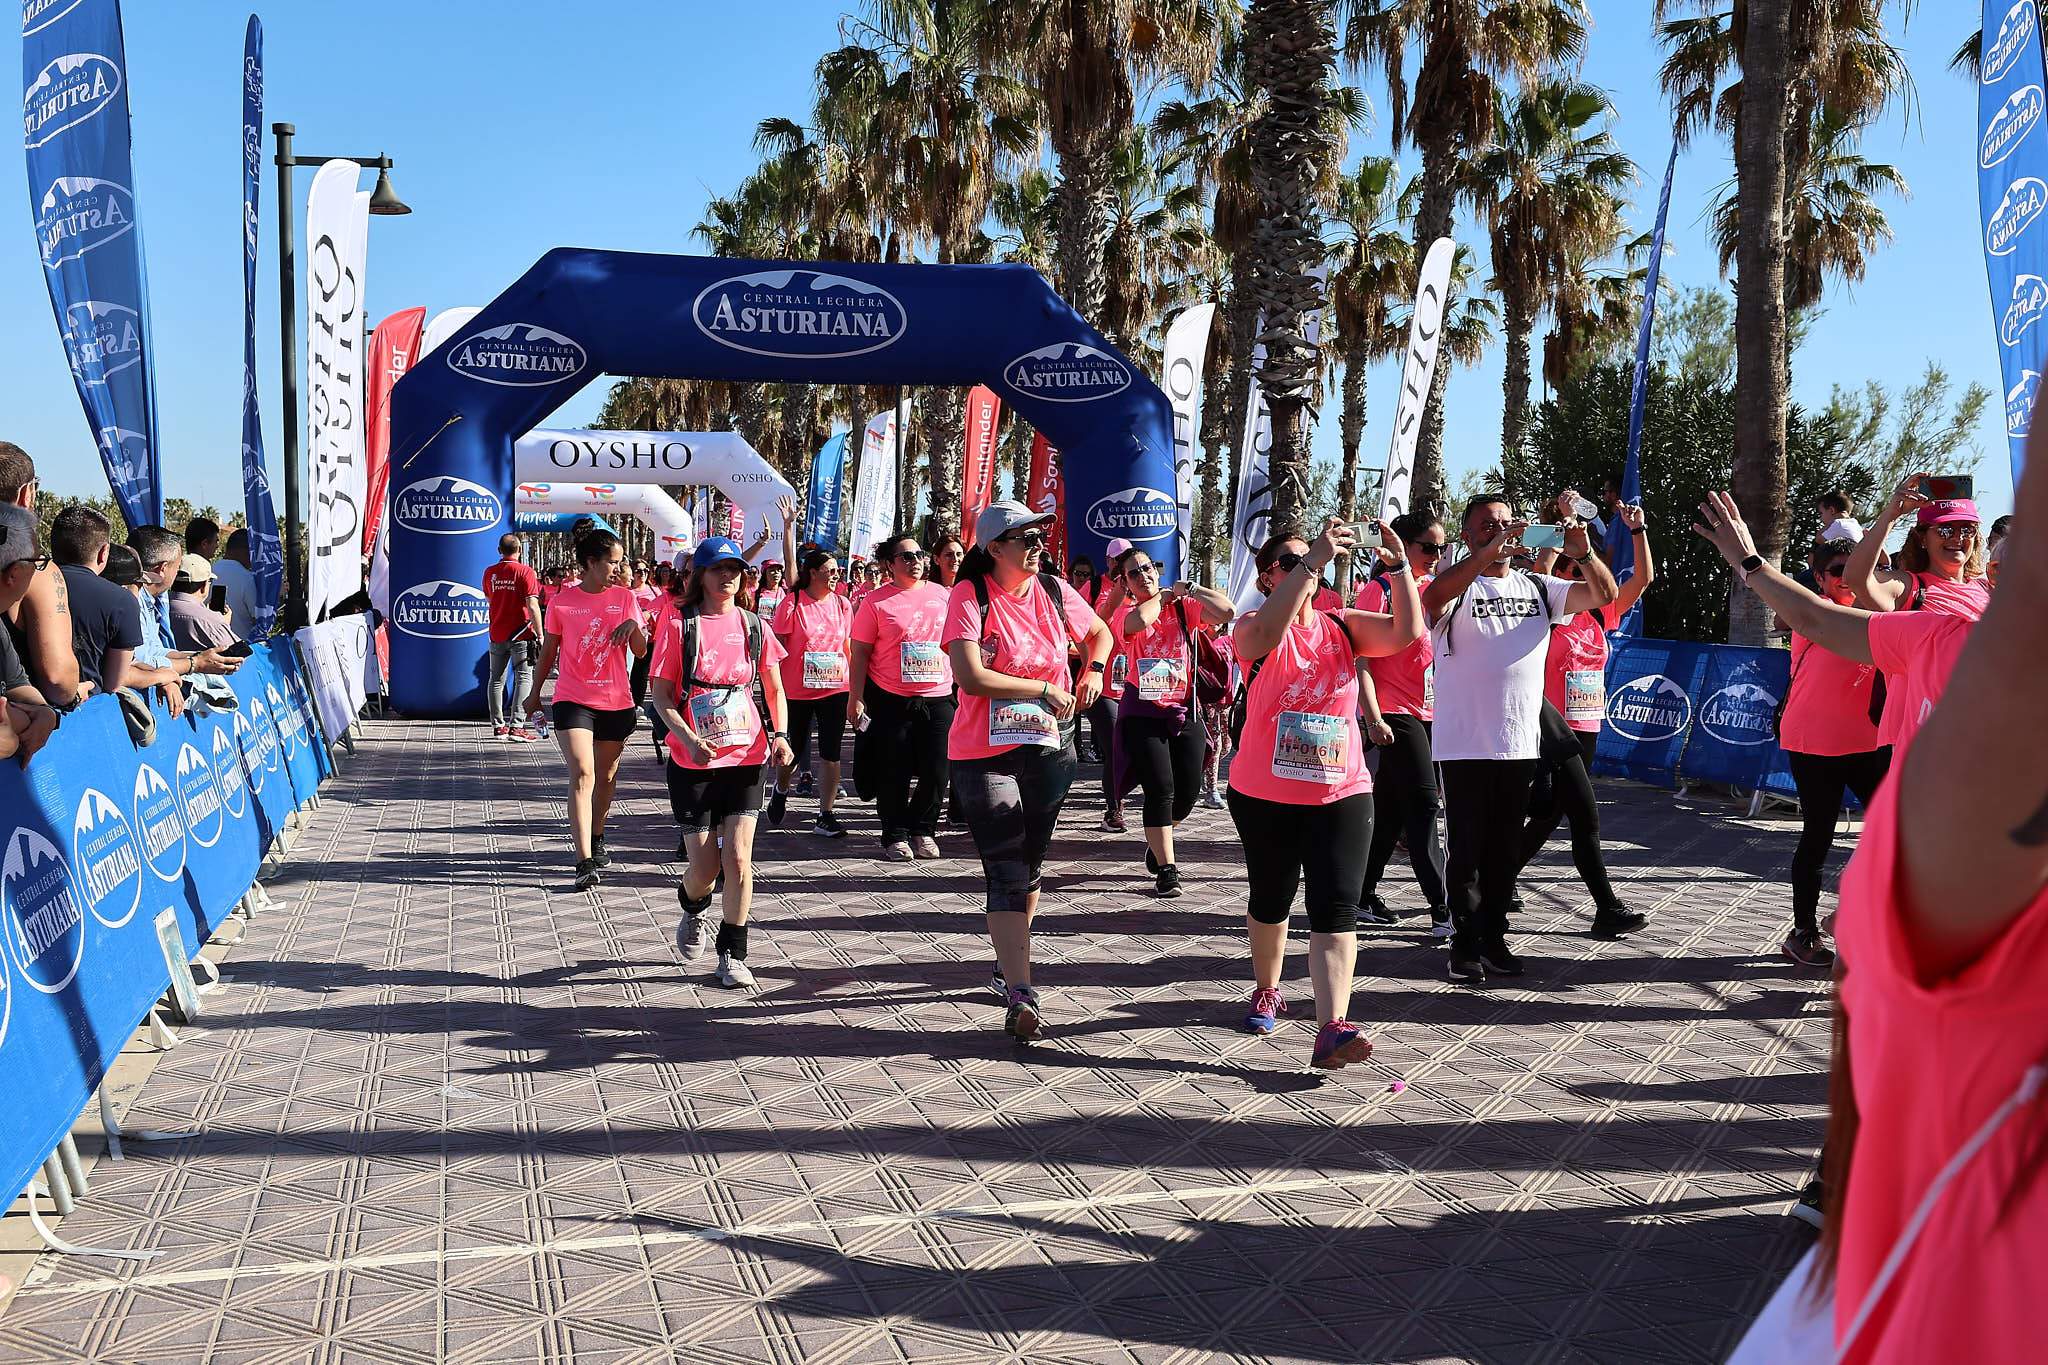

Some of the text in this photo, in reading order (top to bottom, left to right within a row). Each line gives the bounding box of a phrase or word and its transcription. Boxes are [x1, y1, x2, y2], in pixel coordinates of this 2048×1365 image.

[743, 293, 885, 308] CENTRAL LECHERA
[708, 292, 892, 337] ASTURIANA
[455, 344, 577, 373] ASTURIANA
[478, 342, 526, 353] CENTRAL
[1014, 365, 1126, 388] ASTURIANA
[1033, 361, 1076, 371] CENTRAL
[549, 439, 693, 470] OYSHO
[975, 401, 993, 497] Santander
[731, 472, 773, 484] OYSHO
[398, 496, 496, 522] ASTURIANA
[453, 495, 493, 505] LECHERA
[1093, 508, 1176, 529] ASTURIANA
[397, 599, 491, 626] ASTURIANA
[409, 599, 448, 608] CENTRAL
[1474, 599, 1539, 617] adidas
[1610, 694, 1682, 729] ASTURIANA
[86, 834, 107, 858] CENTRAL
[140, 811, 183, 861] ASTURIANA
[81, 841, 139, 908] ASTURIANA
[16, 881, 42, 910] CENTRAL
[10, 885, 81, 970] ASTURIANA
